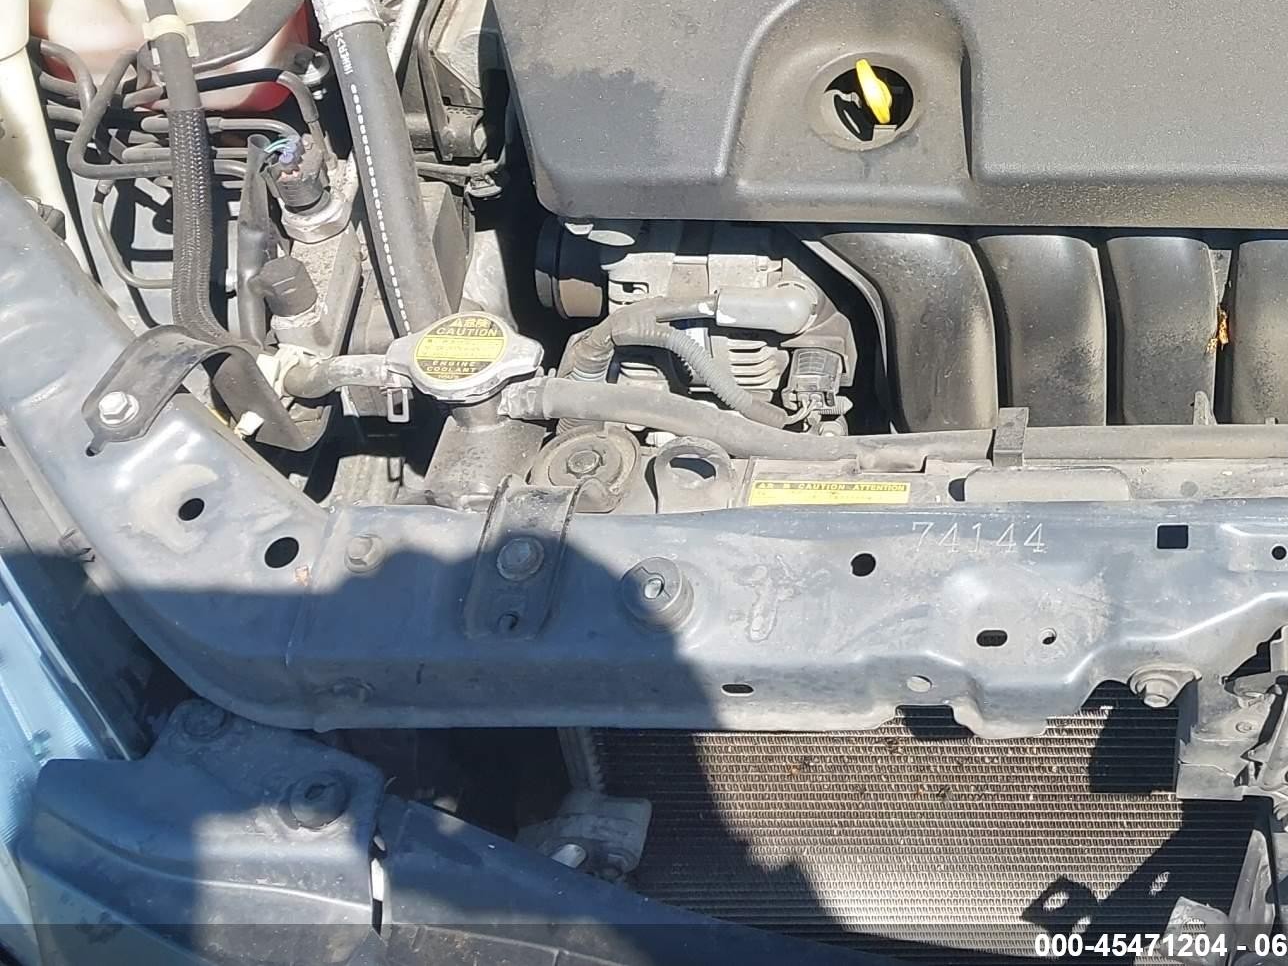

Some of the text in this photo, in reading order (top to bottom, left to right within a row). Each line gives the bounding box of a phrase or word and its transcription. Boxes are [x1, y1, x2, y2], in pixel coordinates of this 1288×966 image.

[436, 327, 498, 337] CAUTION
[853, 484, 905, 492] ATTENTION
[912, 521, 1048, 554] 74144
